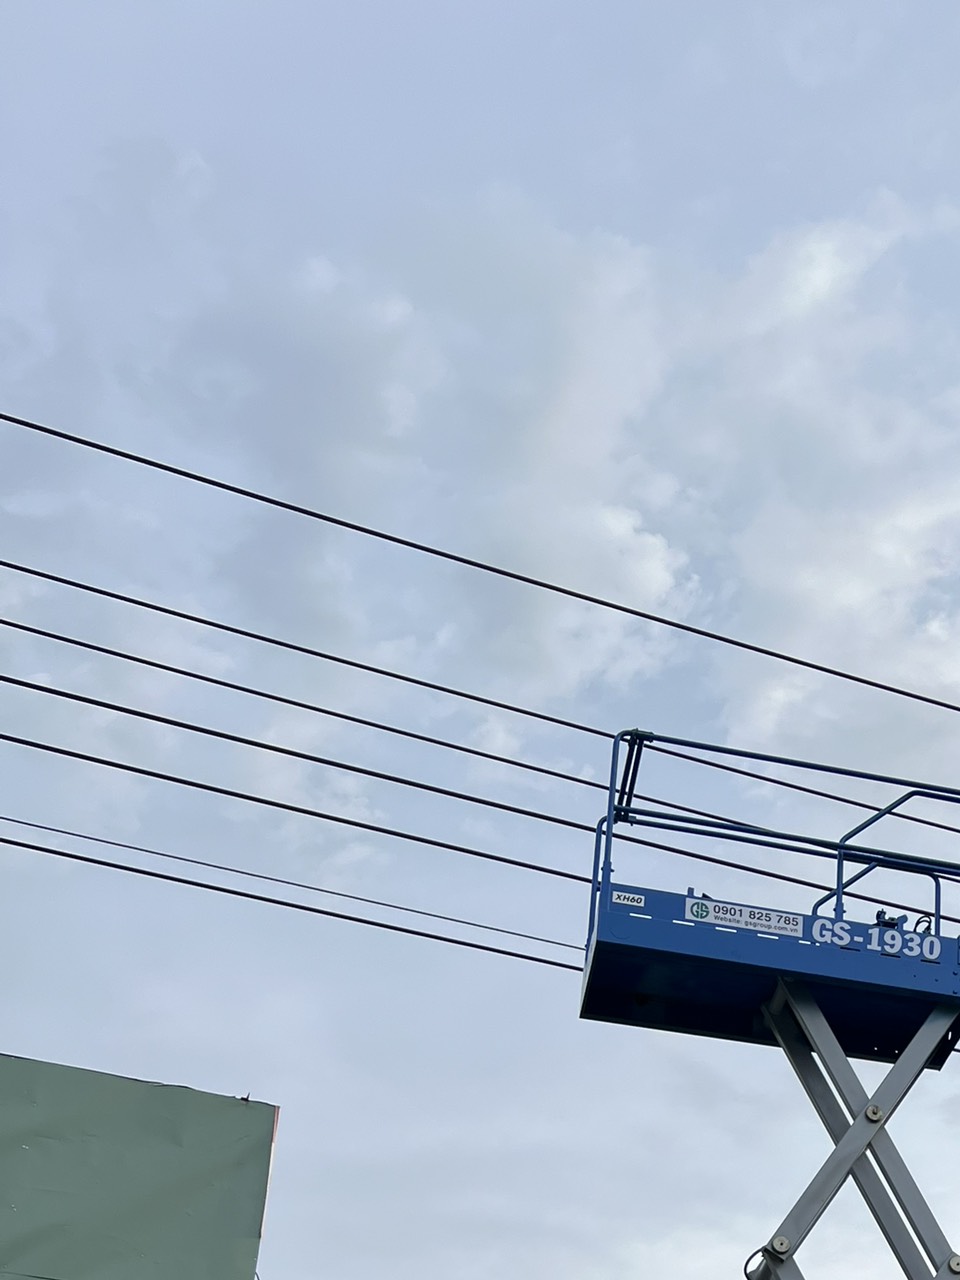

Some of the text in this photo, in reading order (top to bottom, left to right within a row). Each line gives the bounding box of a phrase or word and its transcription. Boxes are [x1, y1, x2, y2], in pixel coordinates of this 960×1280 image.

[615, 893, 643, 905] XH60
[713, 904, 799, 927] 0901 825 785
[714, 914, 743, 925] Website:
[812, 918, 941, 960] GS-1930
